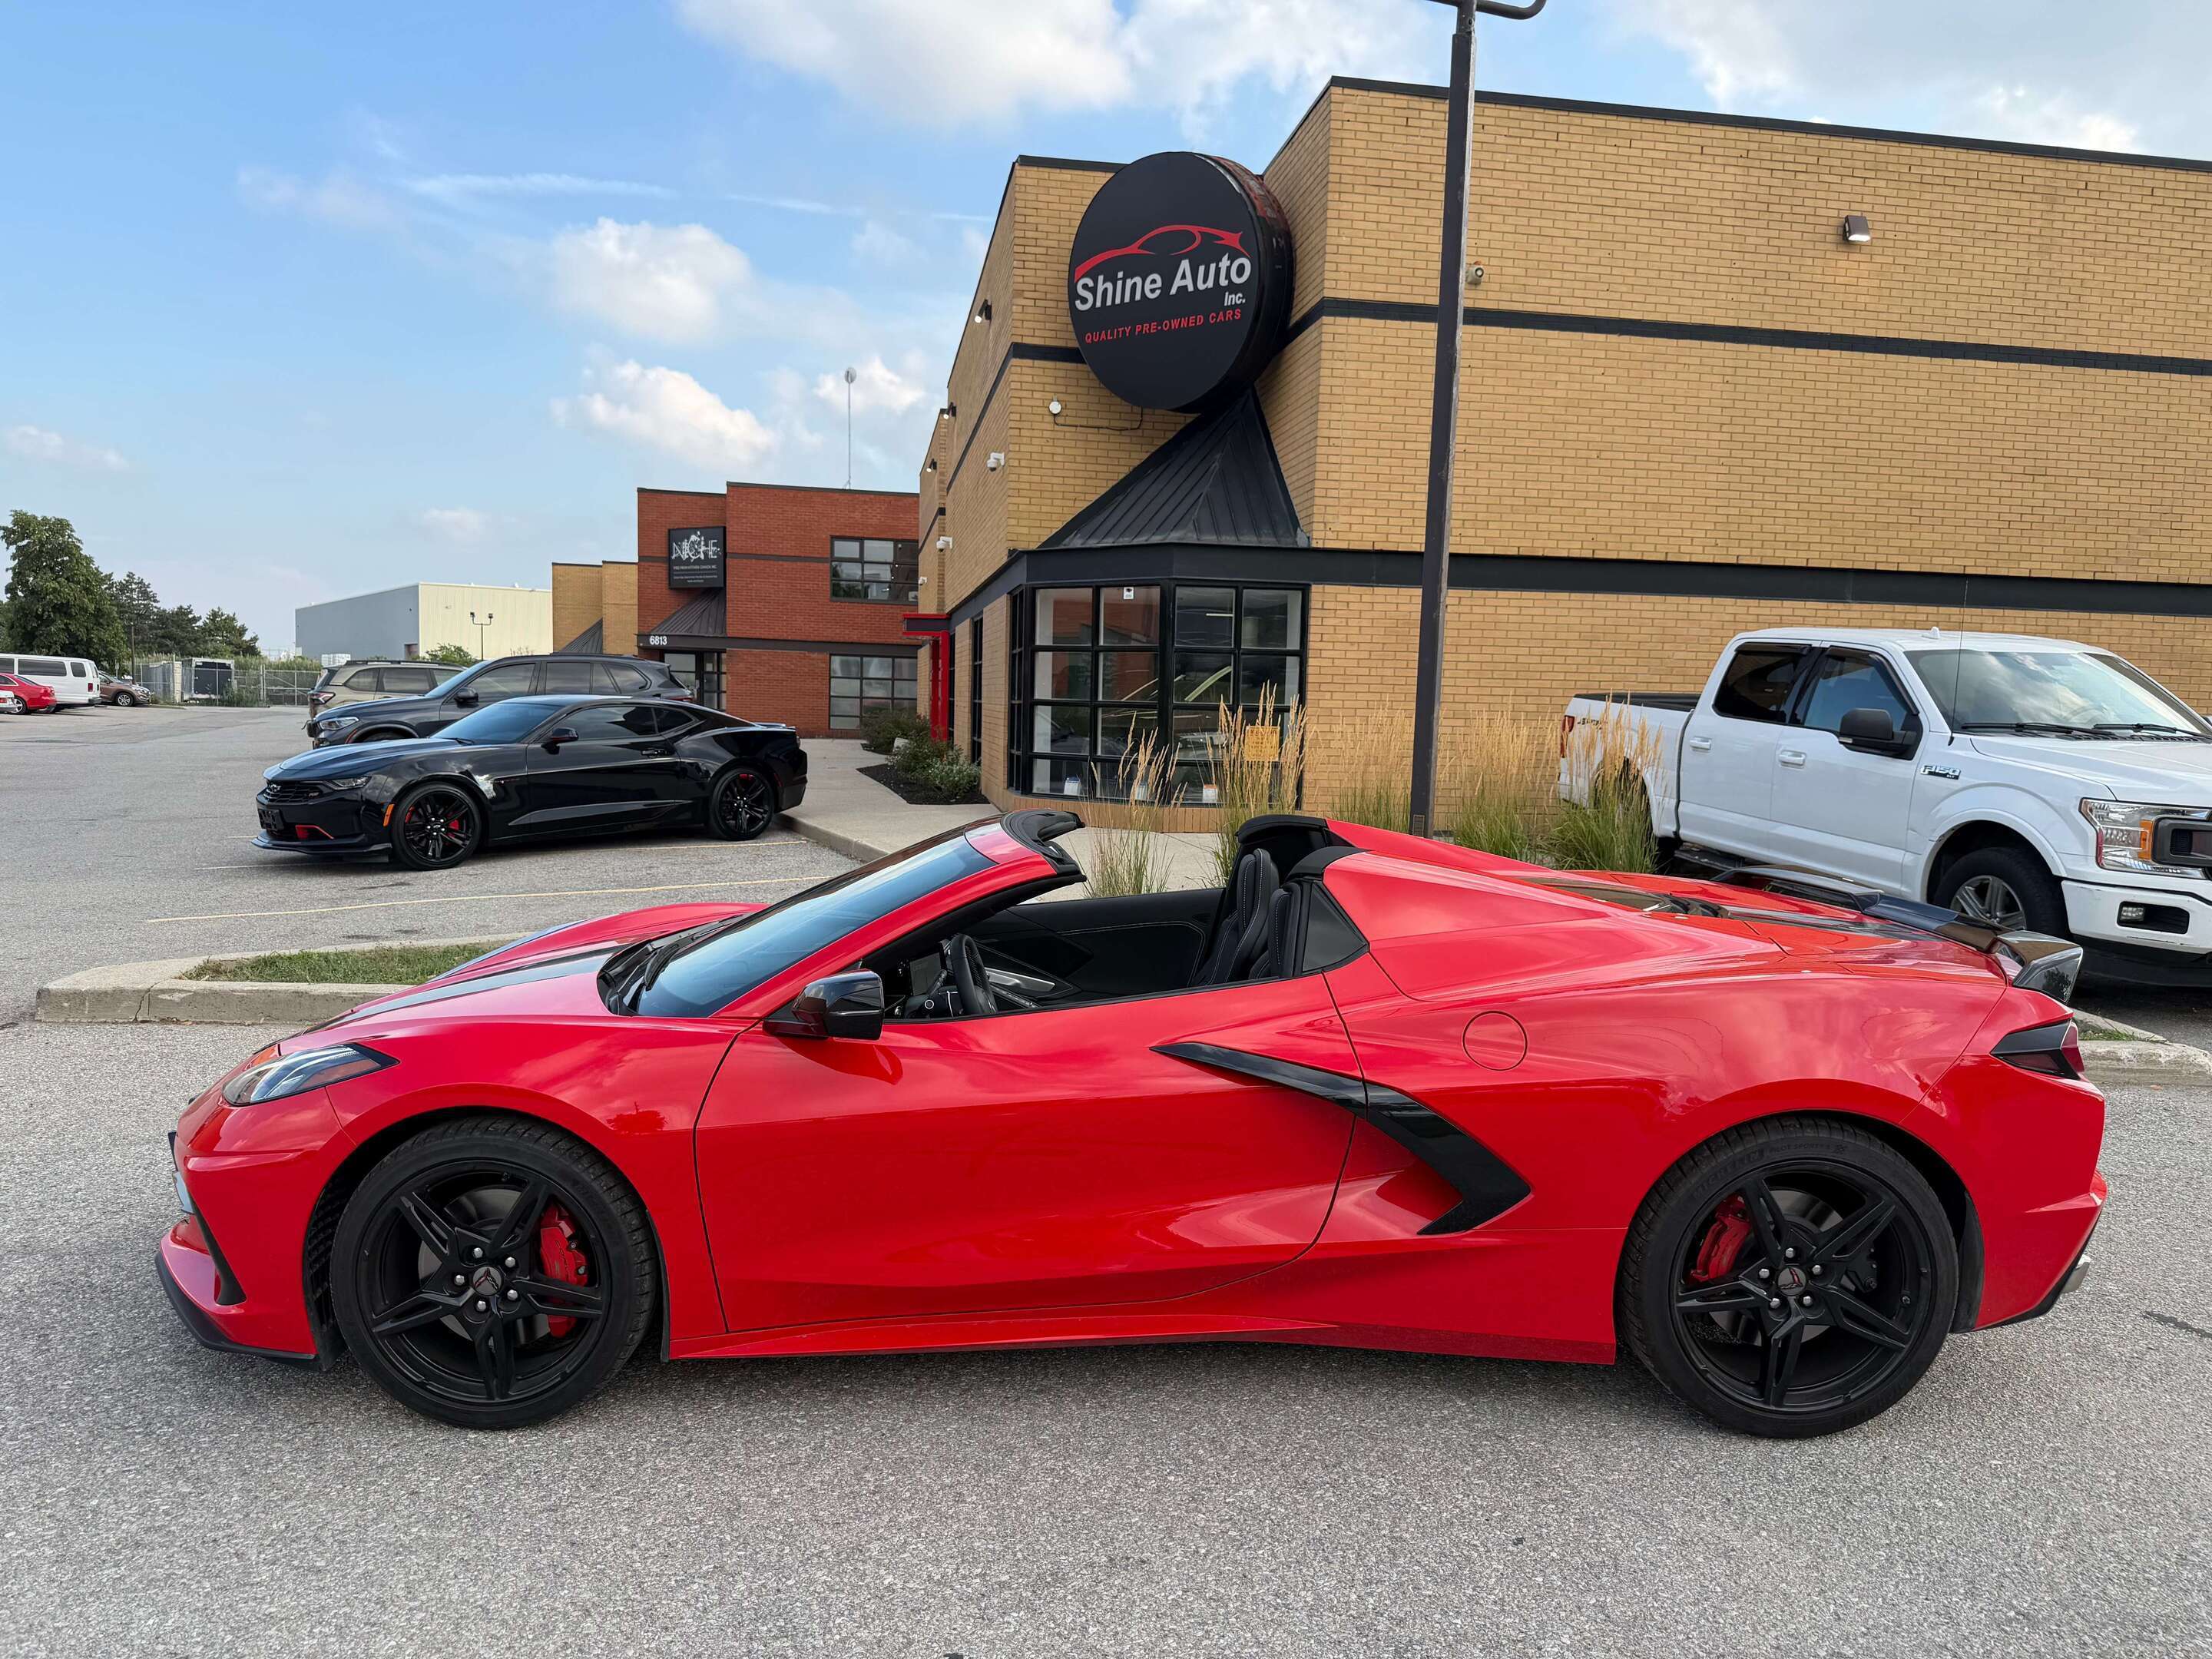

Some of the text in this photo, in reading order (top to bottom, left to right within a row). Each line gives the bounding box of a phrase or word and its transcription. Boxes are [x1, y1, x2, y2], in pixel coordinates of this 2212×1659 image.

[1075, 253, 1251, 310] Shine Auto
[1224, 291, 1246, 306] Inc.
[1084, 308, 1242, 344] QUALITY PRE-OWNED CARS
[649, 635, 667, 645] 6813
